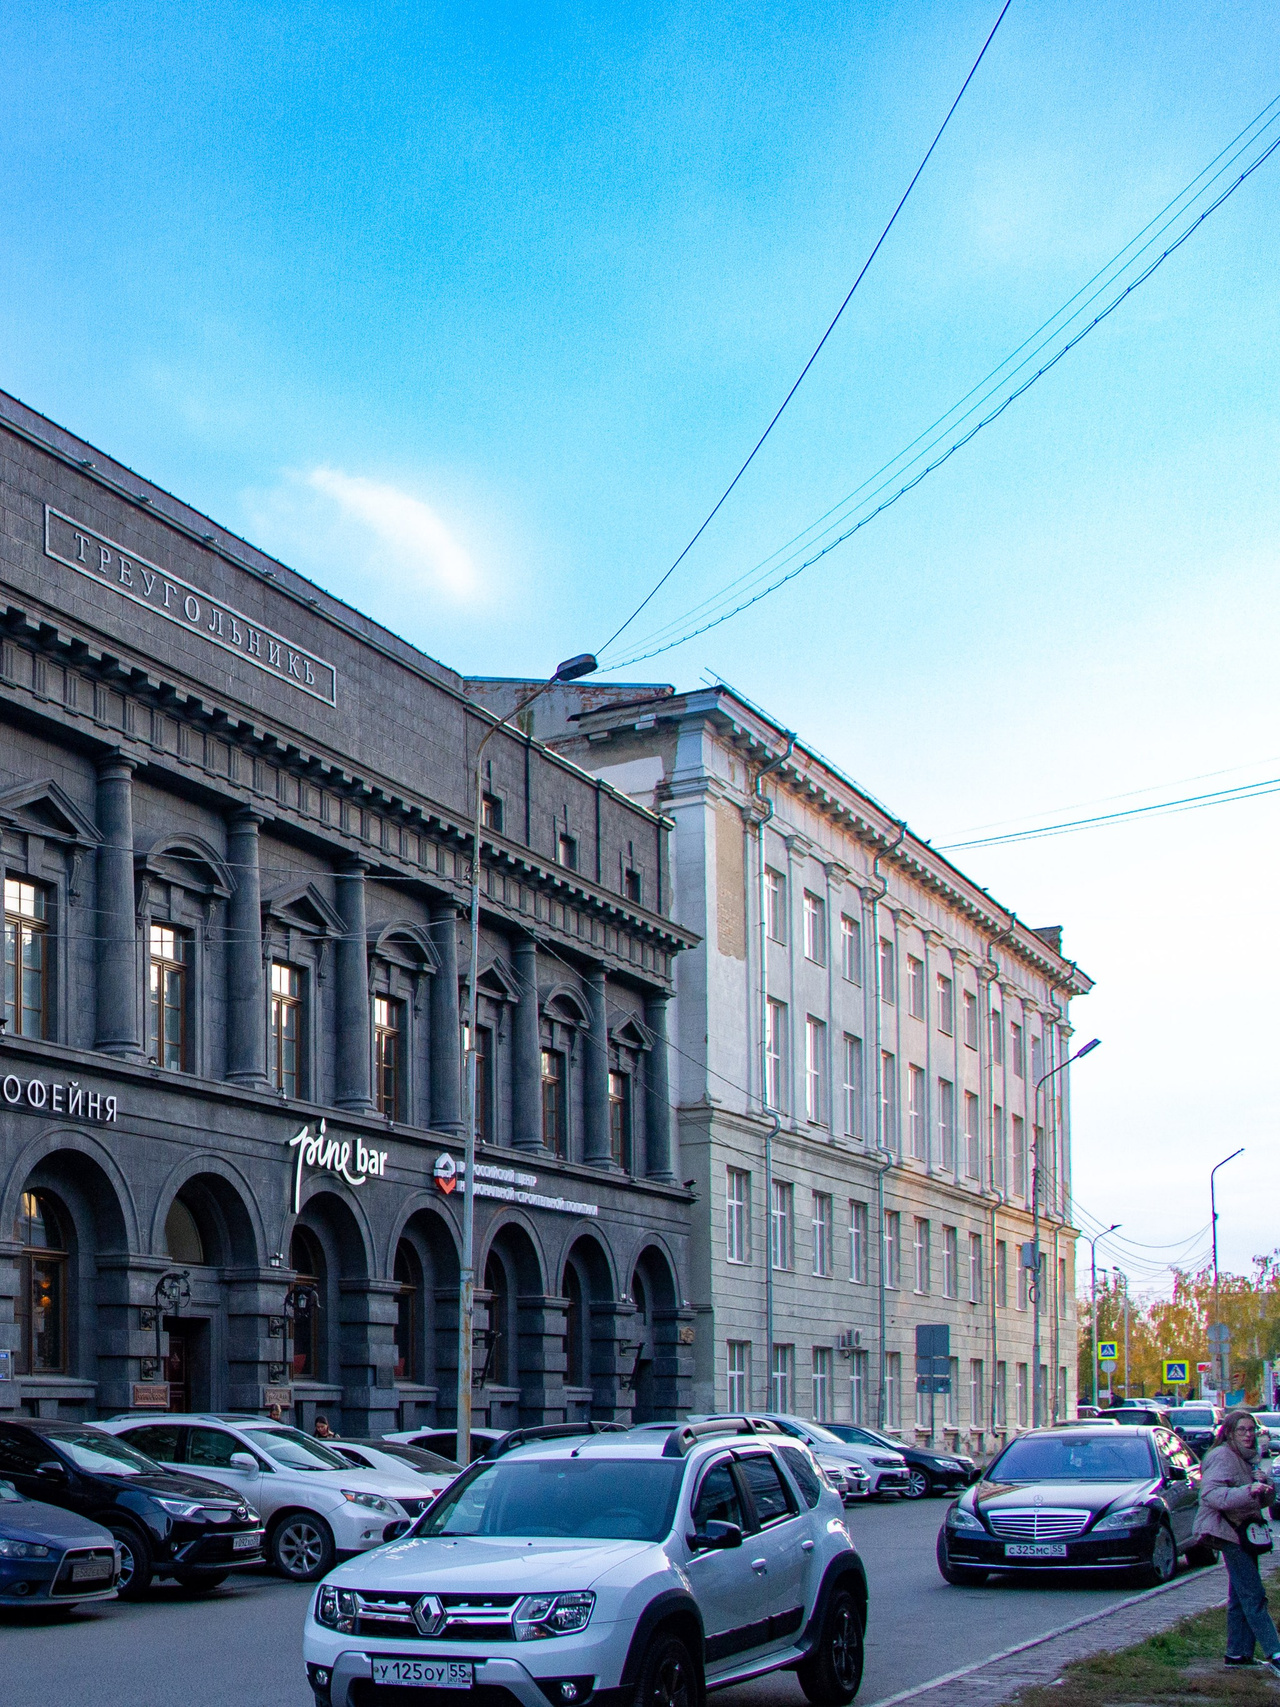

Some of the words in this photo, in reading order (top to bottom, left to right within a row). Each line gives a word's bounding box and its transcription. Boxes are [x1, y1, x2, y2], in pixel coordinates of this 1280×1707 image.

[73, 532, 315, 685] ТРЕУГОЛЬНИКЪ
[289, 1118, 366, 1214] pine
[356, 1138, 388, 1176] bar
[457, 1161, 515, 1183] ВРОССИЙСКИЙ
[449, 1663, 466, 1678] 55
